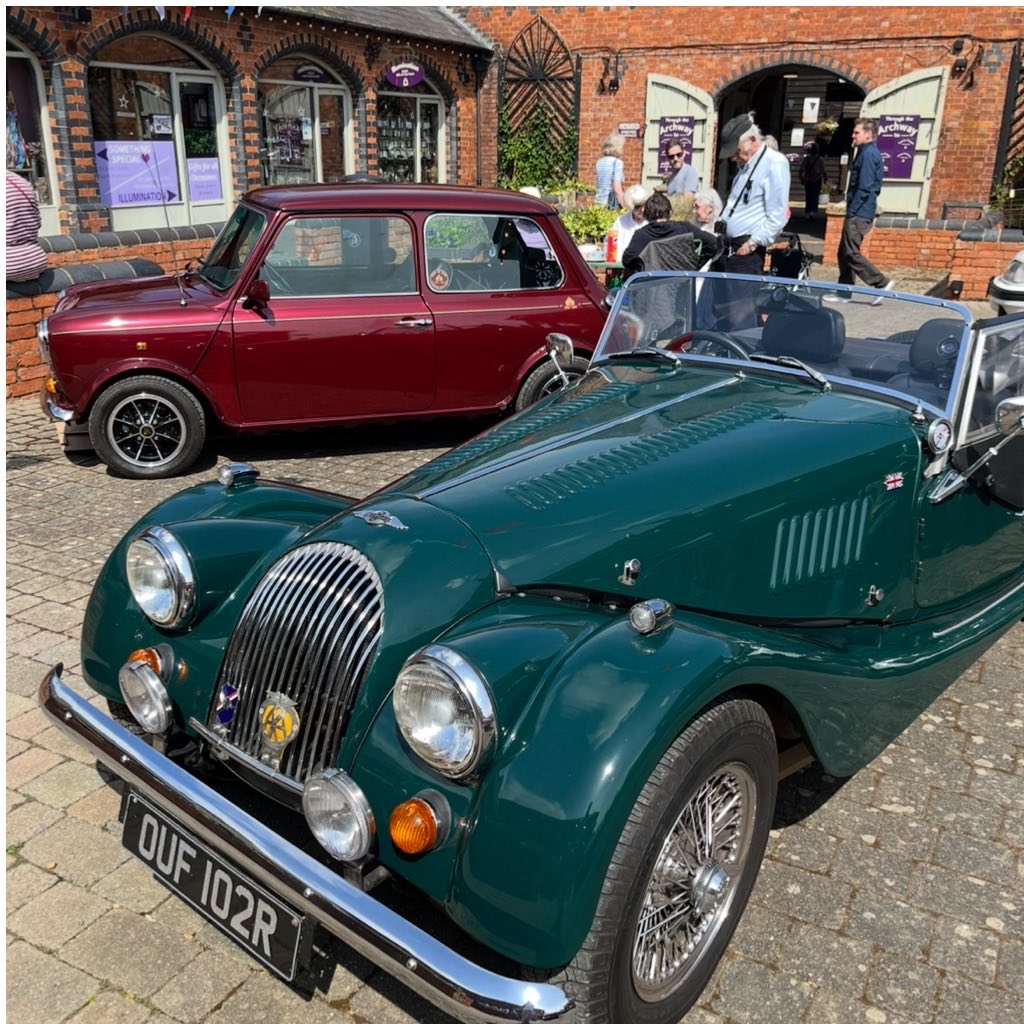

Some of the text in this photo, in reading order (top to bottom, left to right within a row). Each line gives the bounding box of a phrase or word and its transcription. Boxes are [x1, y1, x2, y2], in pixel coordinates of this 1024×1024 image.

[660, 122, 693, 136] Archway
[878, 121, 918, 136] Archway
[118, 190, 167, 203] ILLUMINATION
[200, 859, 278, 959] 102R
